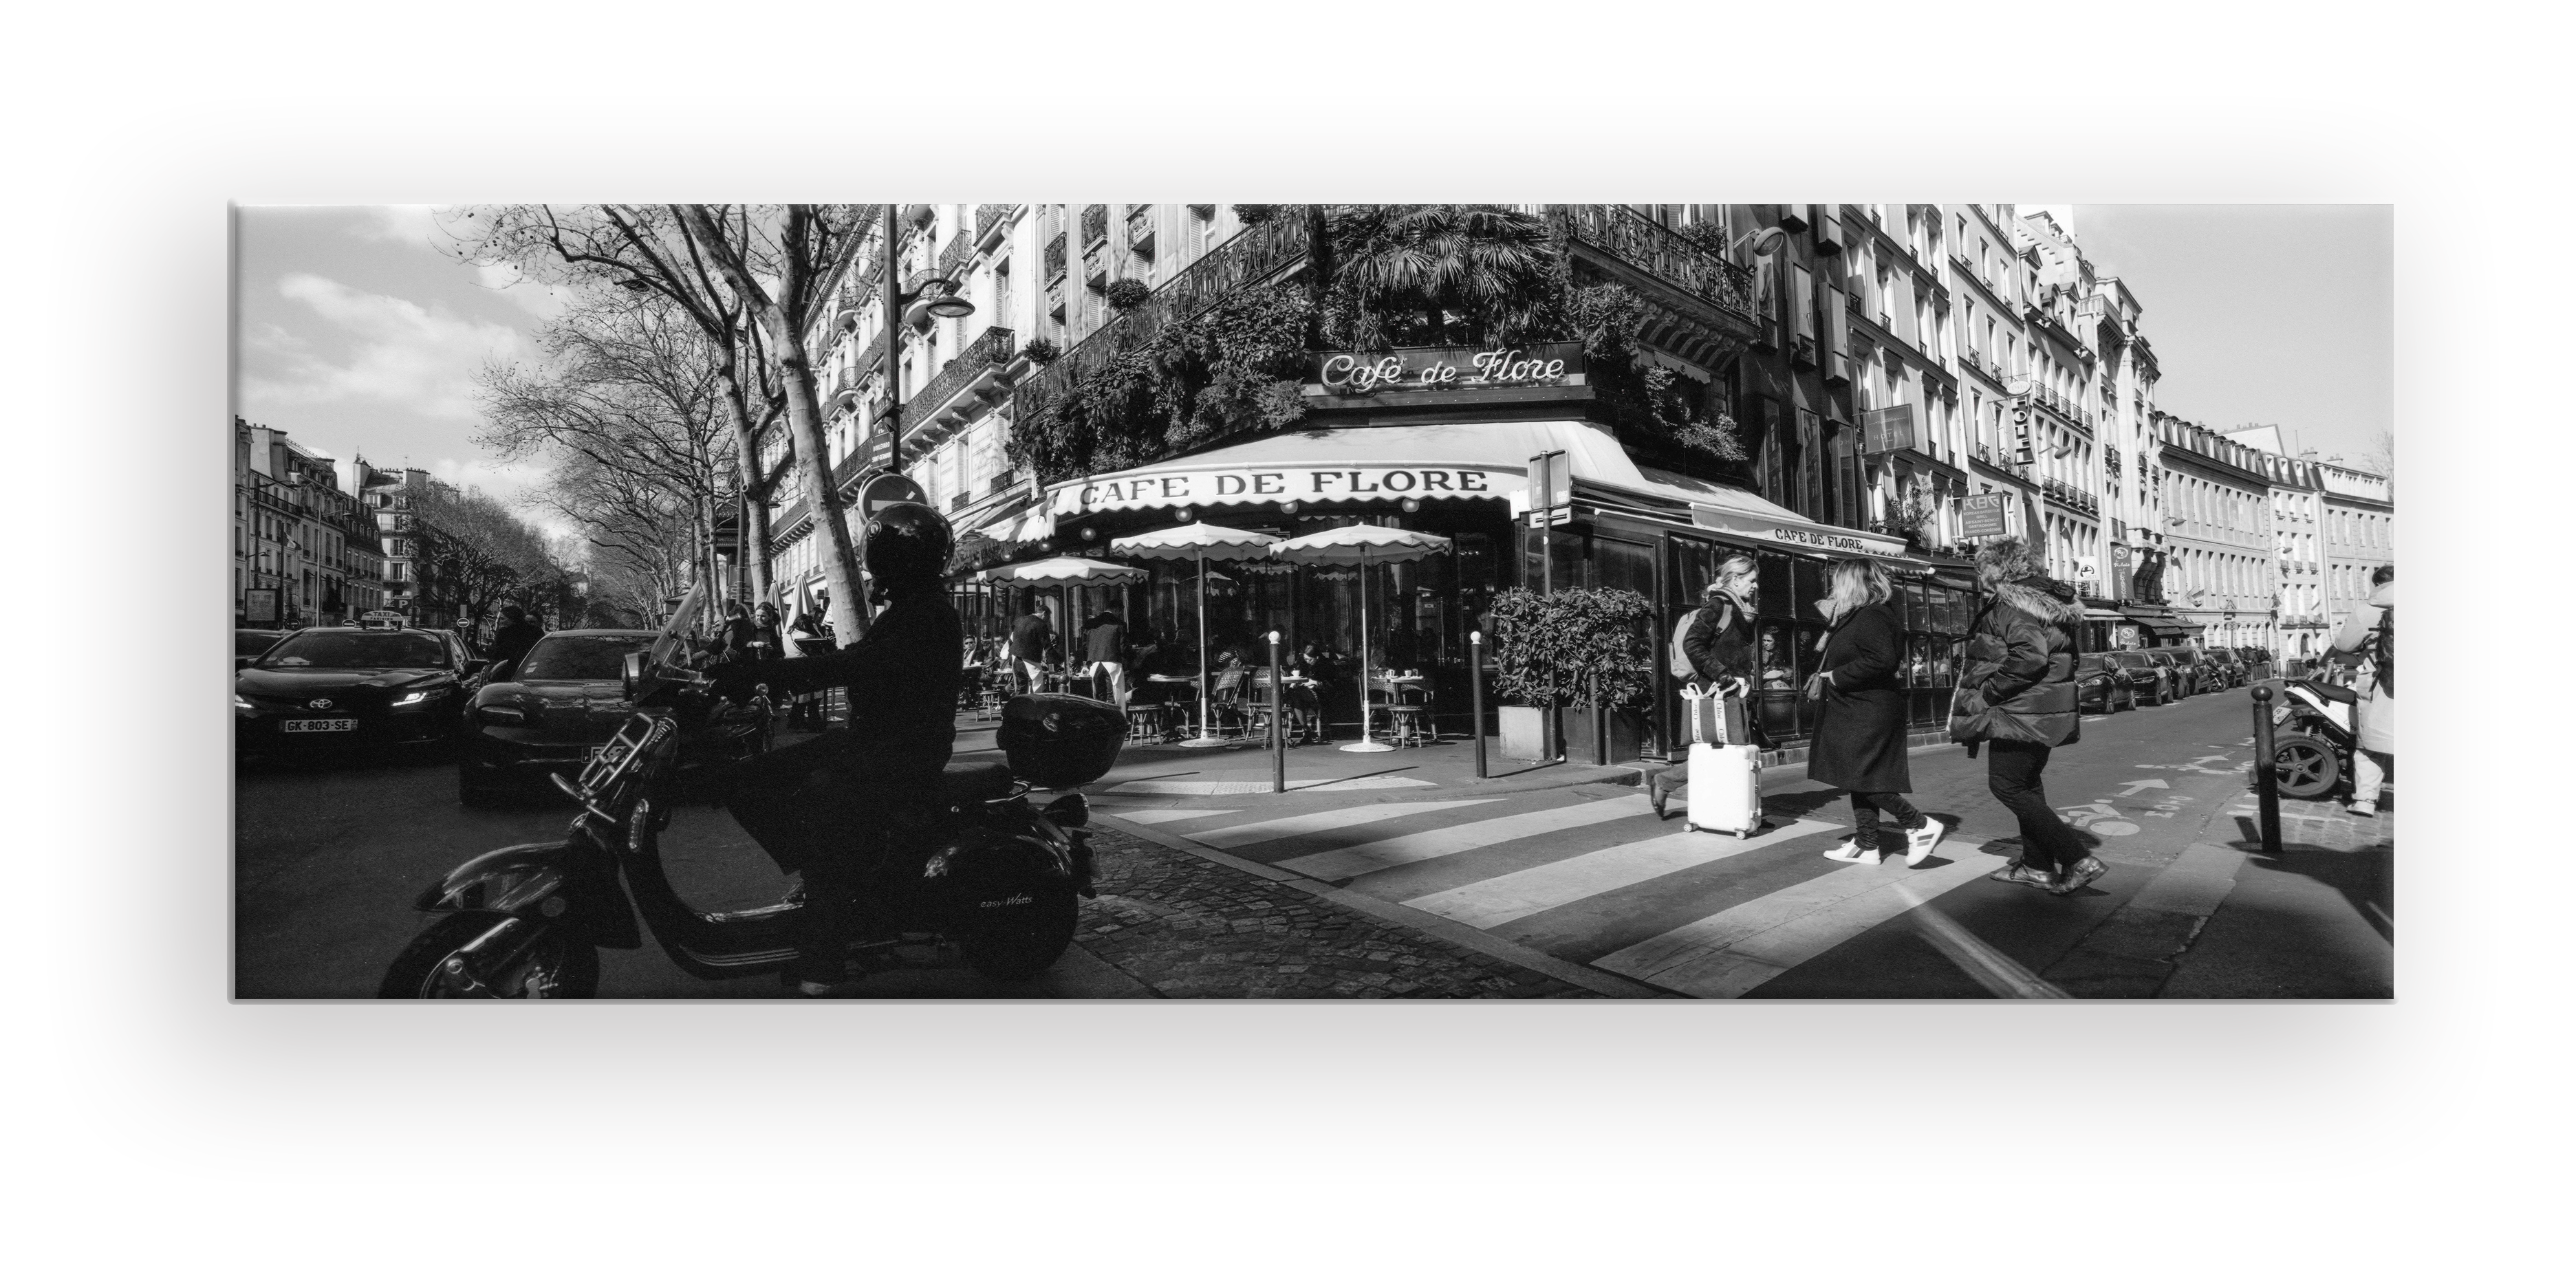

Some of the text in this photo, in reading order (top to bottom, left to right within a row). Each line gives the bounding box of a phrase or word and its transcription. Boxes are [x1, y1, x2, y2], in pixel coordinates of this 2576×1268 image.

[1321, 347, 1565, 393] Café de Flore
[1873, 430, 1904, 440] HOTEL
[2011, 396, 2033, 464] HOTEL
[1080, 470, 1488, 505] CAFE DE FLORE
[1775, 529, 1863, 549] CAFE DE FLORE
[288, 720, 349, 730] GK-803-SE
